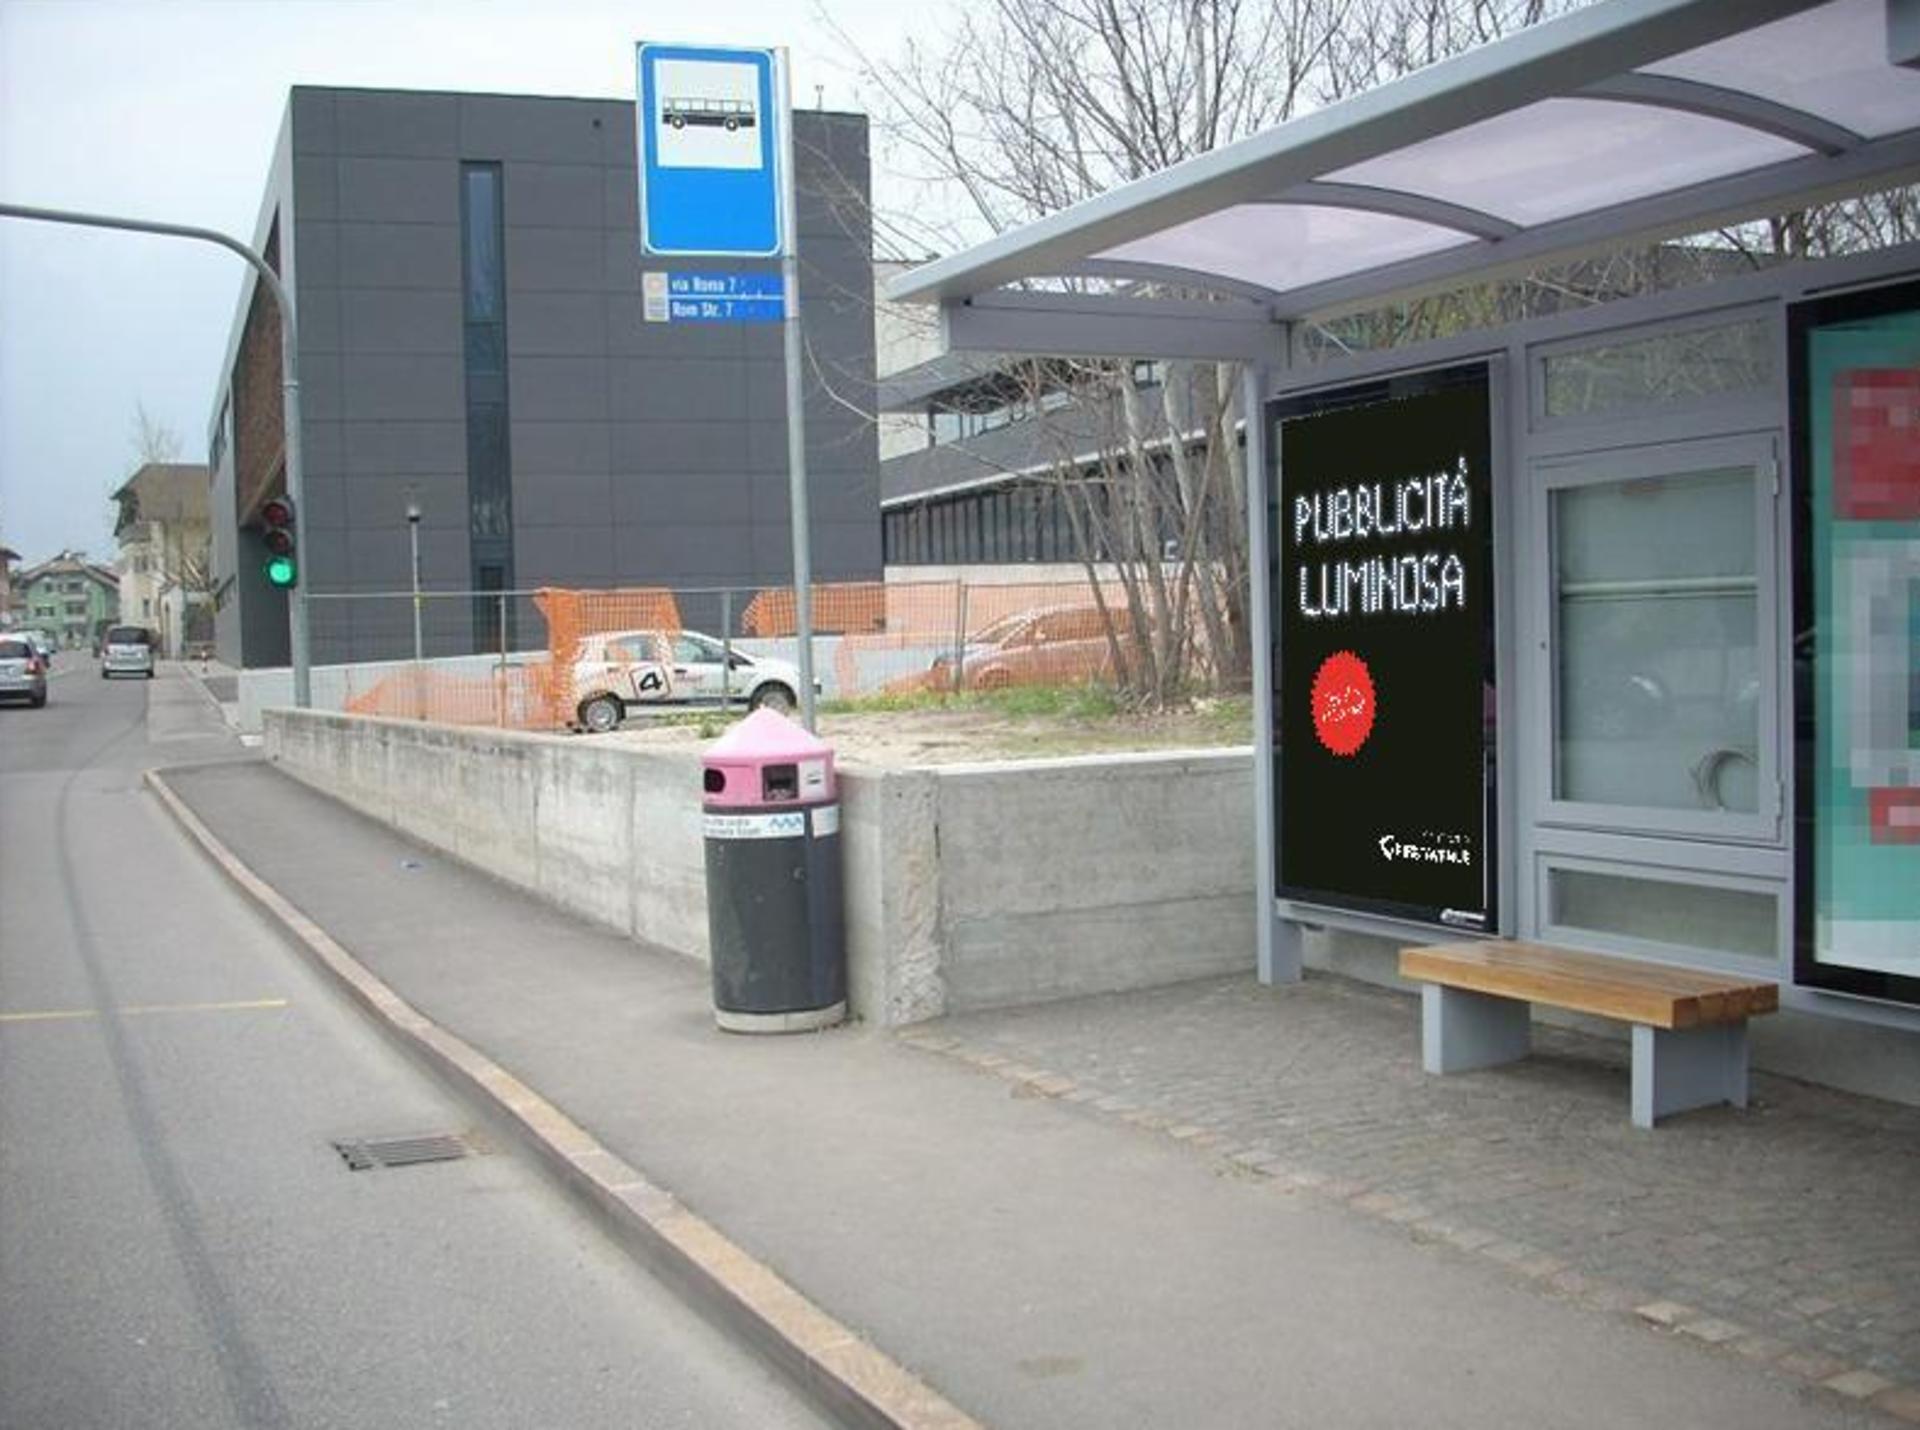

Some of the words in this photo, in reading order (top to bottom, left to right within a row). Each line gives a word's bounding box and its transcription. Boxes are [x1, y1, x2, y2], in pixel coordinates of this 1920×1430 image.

[693, 277, 725, 292] Roma
[672, 301, 698, 317] Rom
[1300, 554, 1464, 615] LUMINOSA
[639, 672, 663, 691] 4
